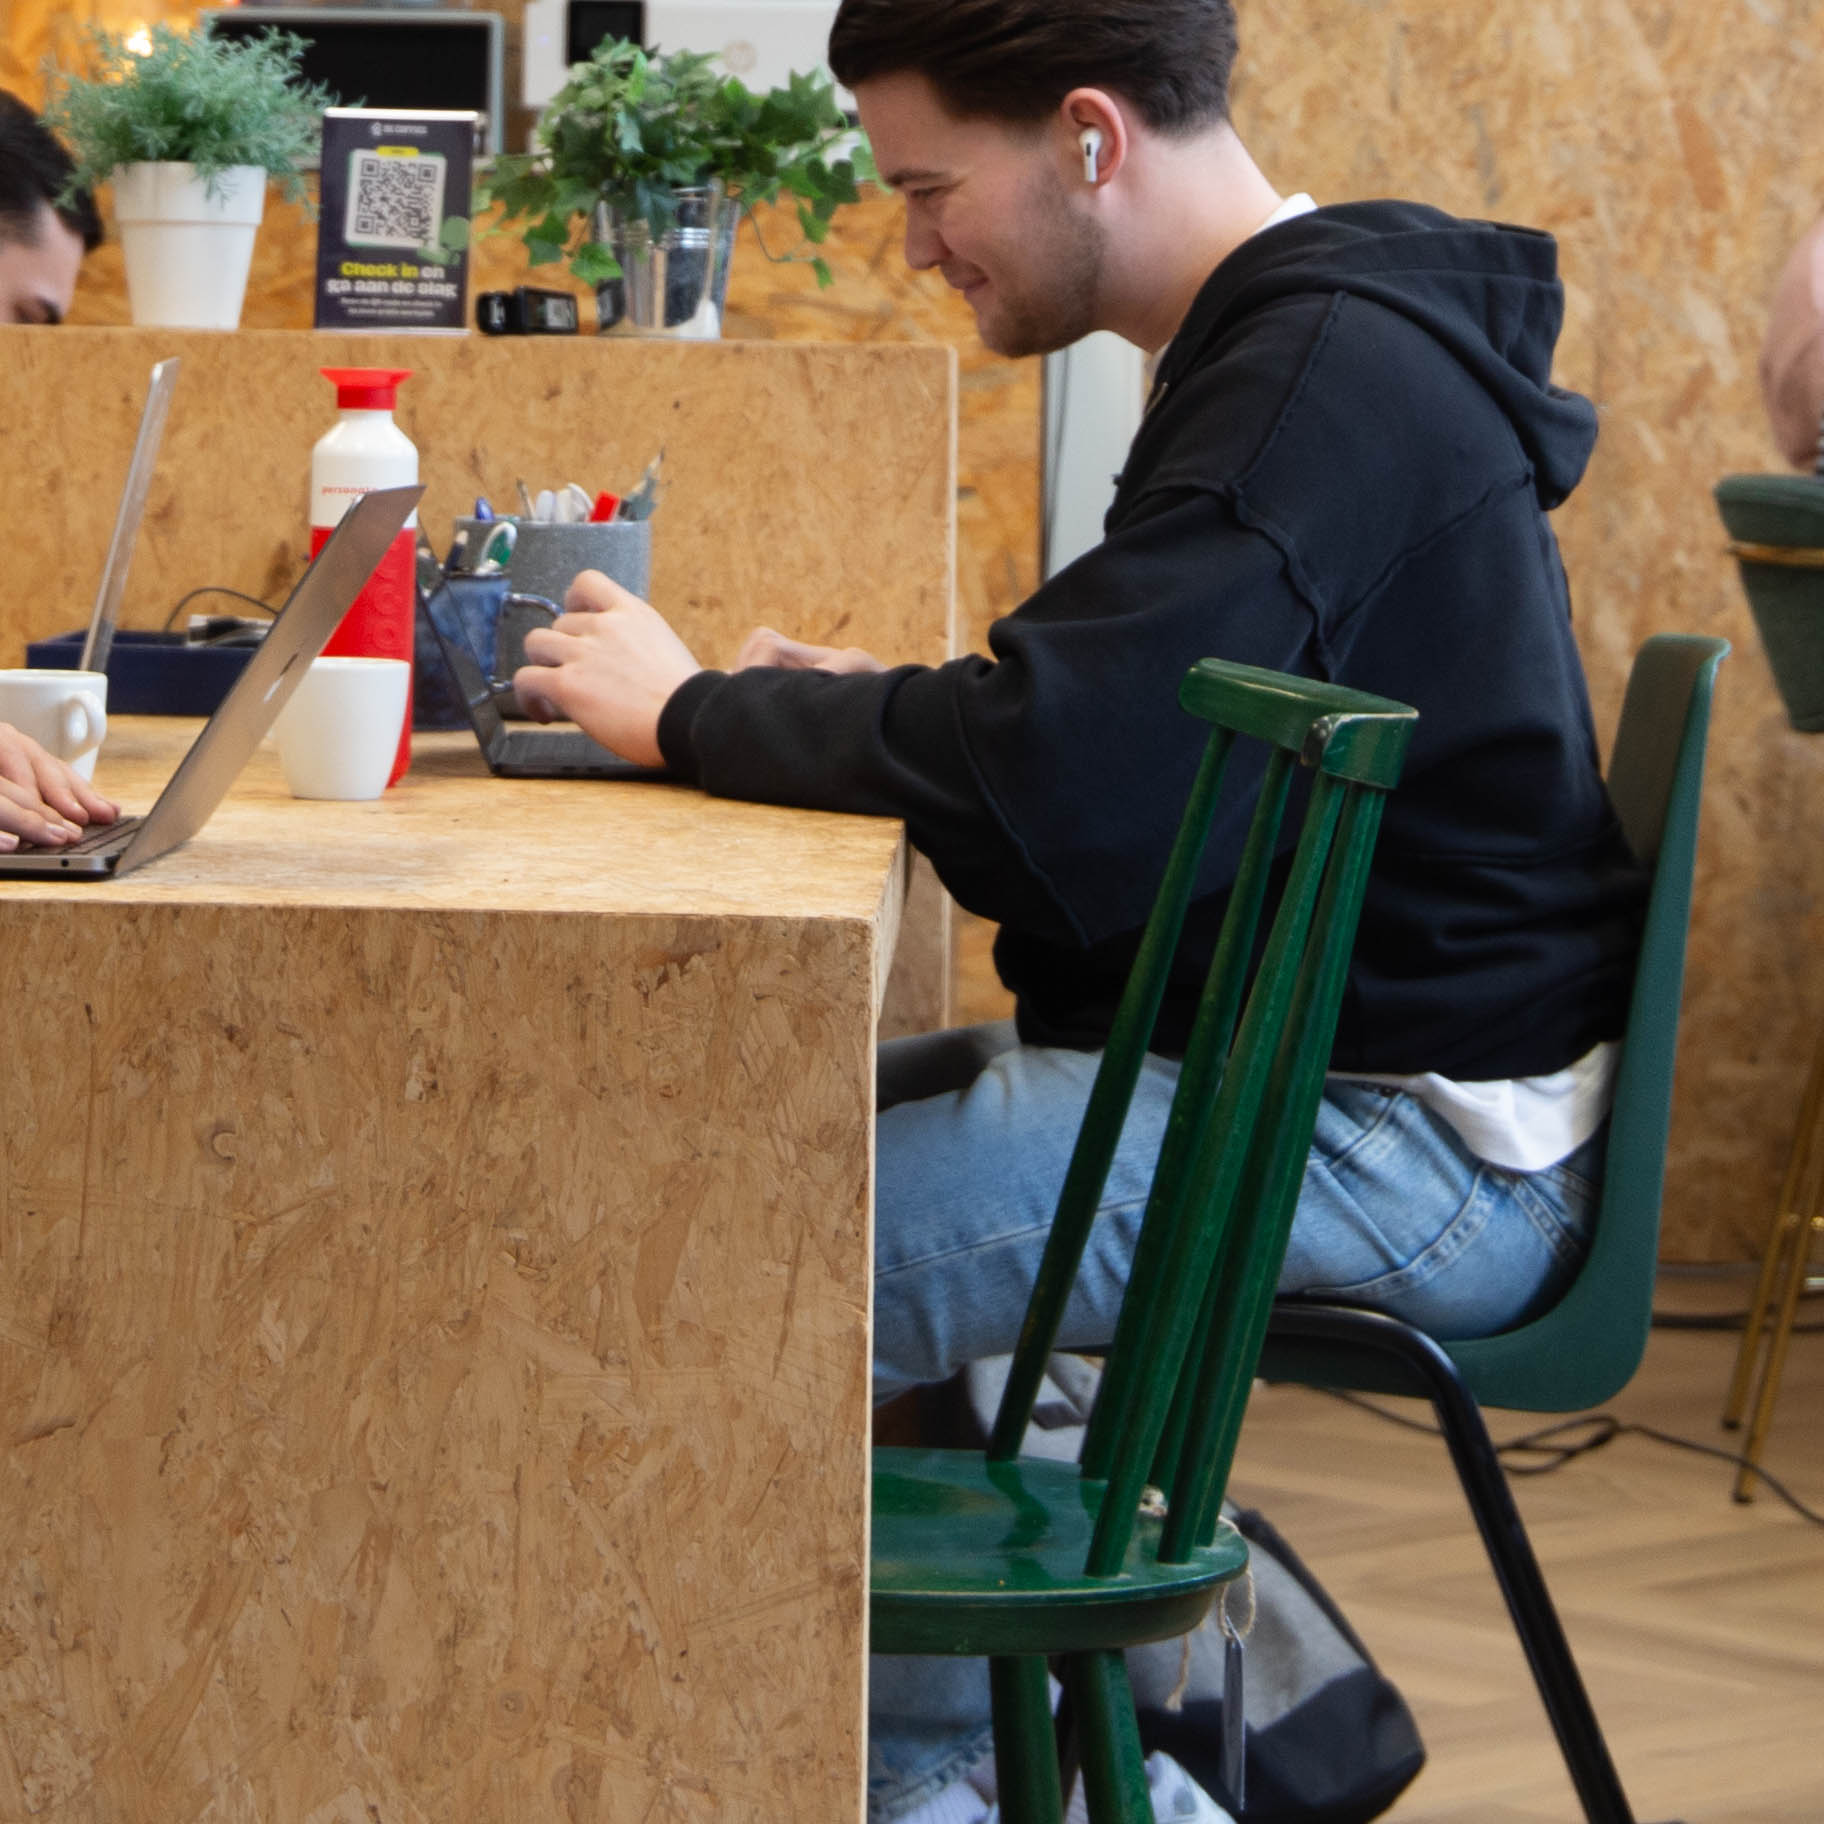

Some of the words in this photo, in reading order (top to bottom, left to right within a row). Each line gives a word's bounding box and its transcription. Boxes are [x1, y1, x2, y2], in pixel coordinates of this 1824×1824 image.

[341, 262, 397, 277] Check
[400, 262, 419, 278] in
[421, 265, 445, 279] en
[354, 280, 389, 293] aan
[391, 280, 415, 294] de
